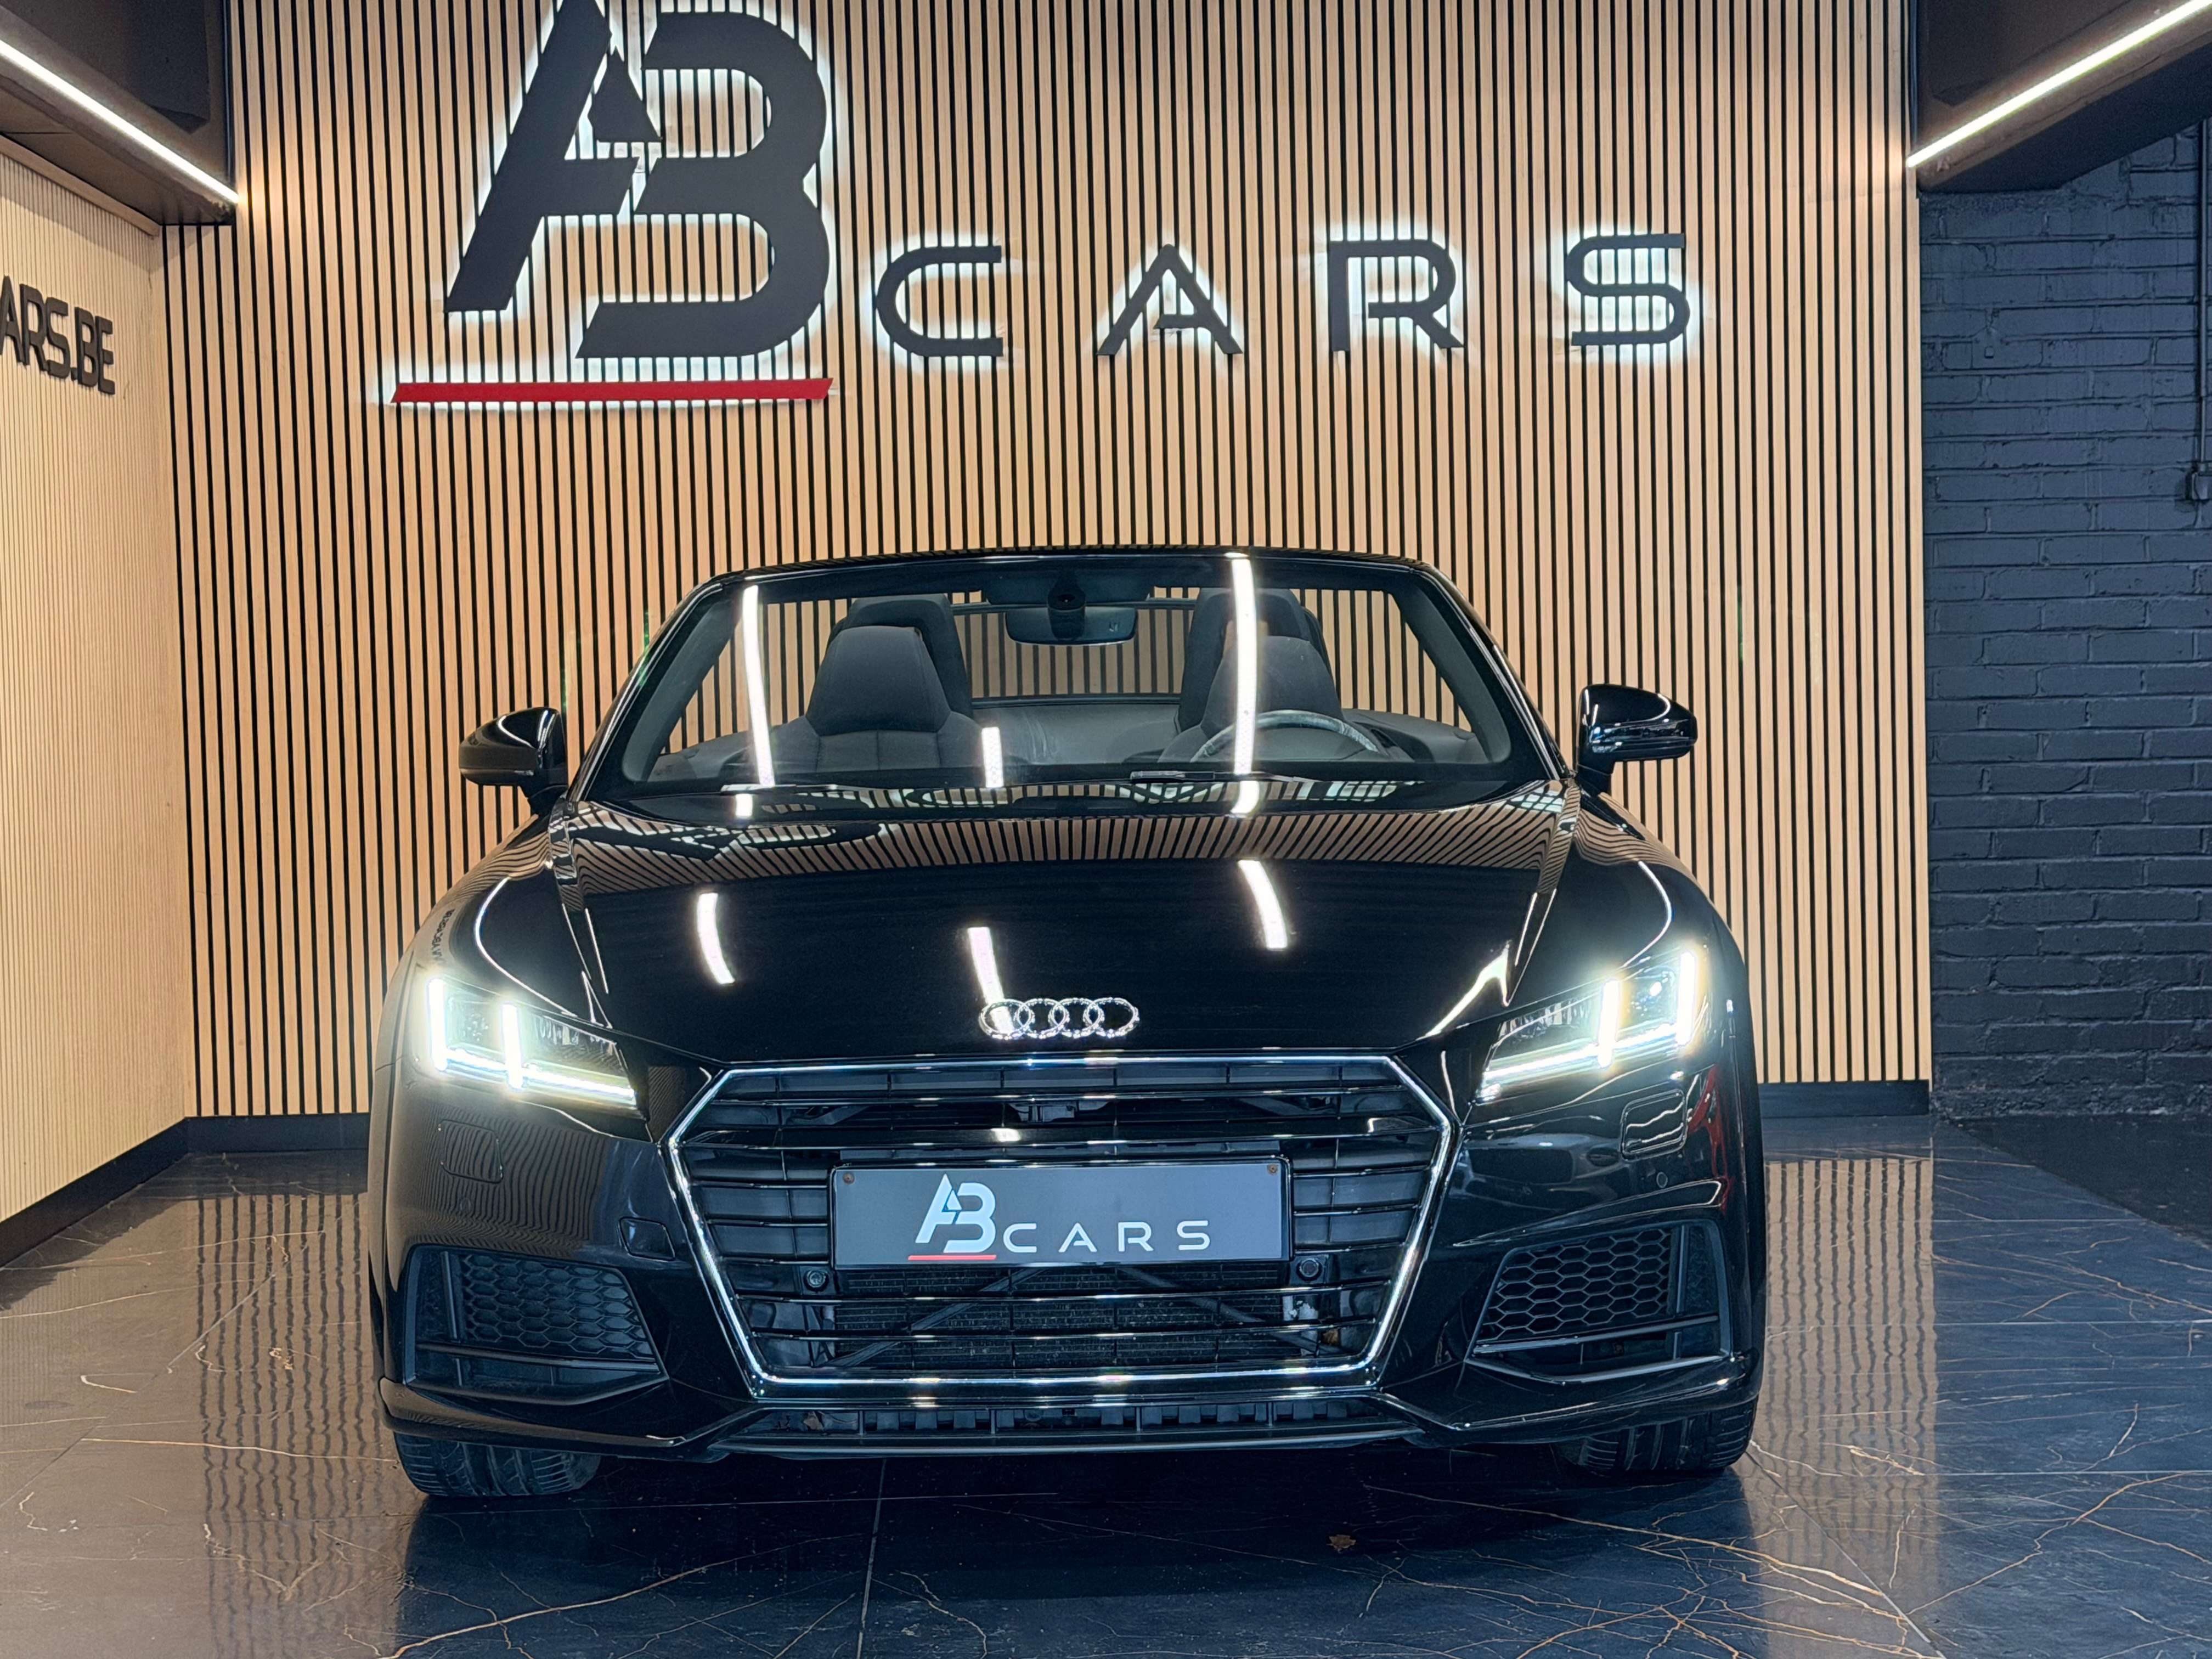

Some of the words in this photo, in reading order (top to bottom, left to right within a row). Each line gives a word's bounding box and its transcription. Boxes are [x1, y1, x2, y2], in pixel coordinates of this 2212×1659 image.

[444, 0, 830, 358] AB
[876, 233, 1690, 358] CARS
[915, 1173, 996, 1254] AB
[1003, 1220, 1211, 1252] CARS
